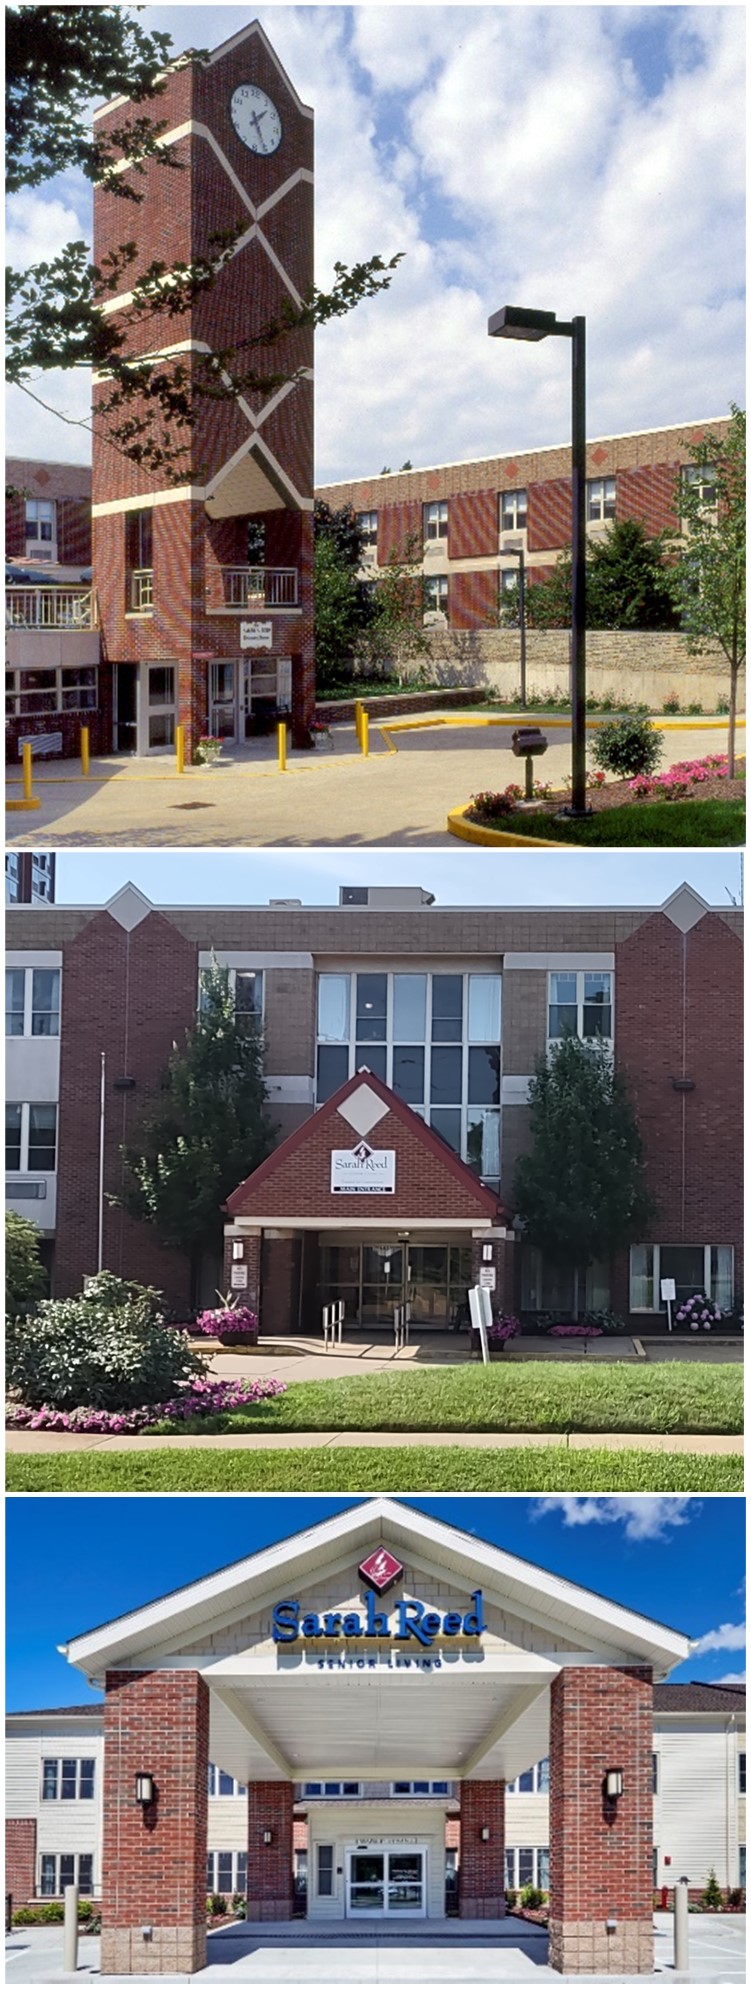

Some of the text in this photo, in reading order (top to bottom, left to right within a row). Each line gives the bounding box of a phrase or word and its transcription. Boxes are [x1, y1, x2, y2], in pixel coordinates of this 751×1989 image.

[335, 1156, 388, 1171] Sarah Reed
[272, 1589, 488, 1646] Sarah Reed
[317, 1658, 443, 1669] SENIOR LIVING
